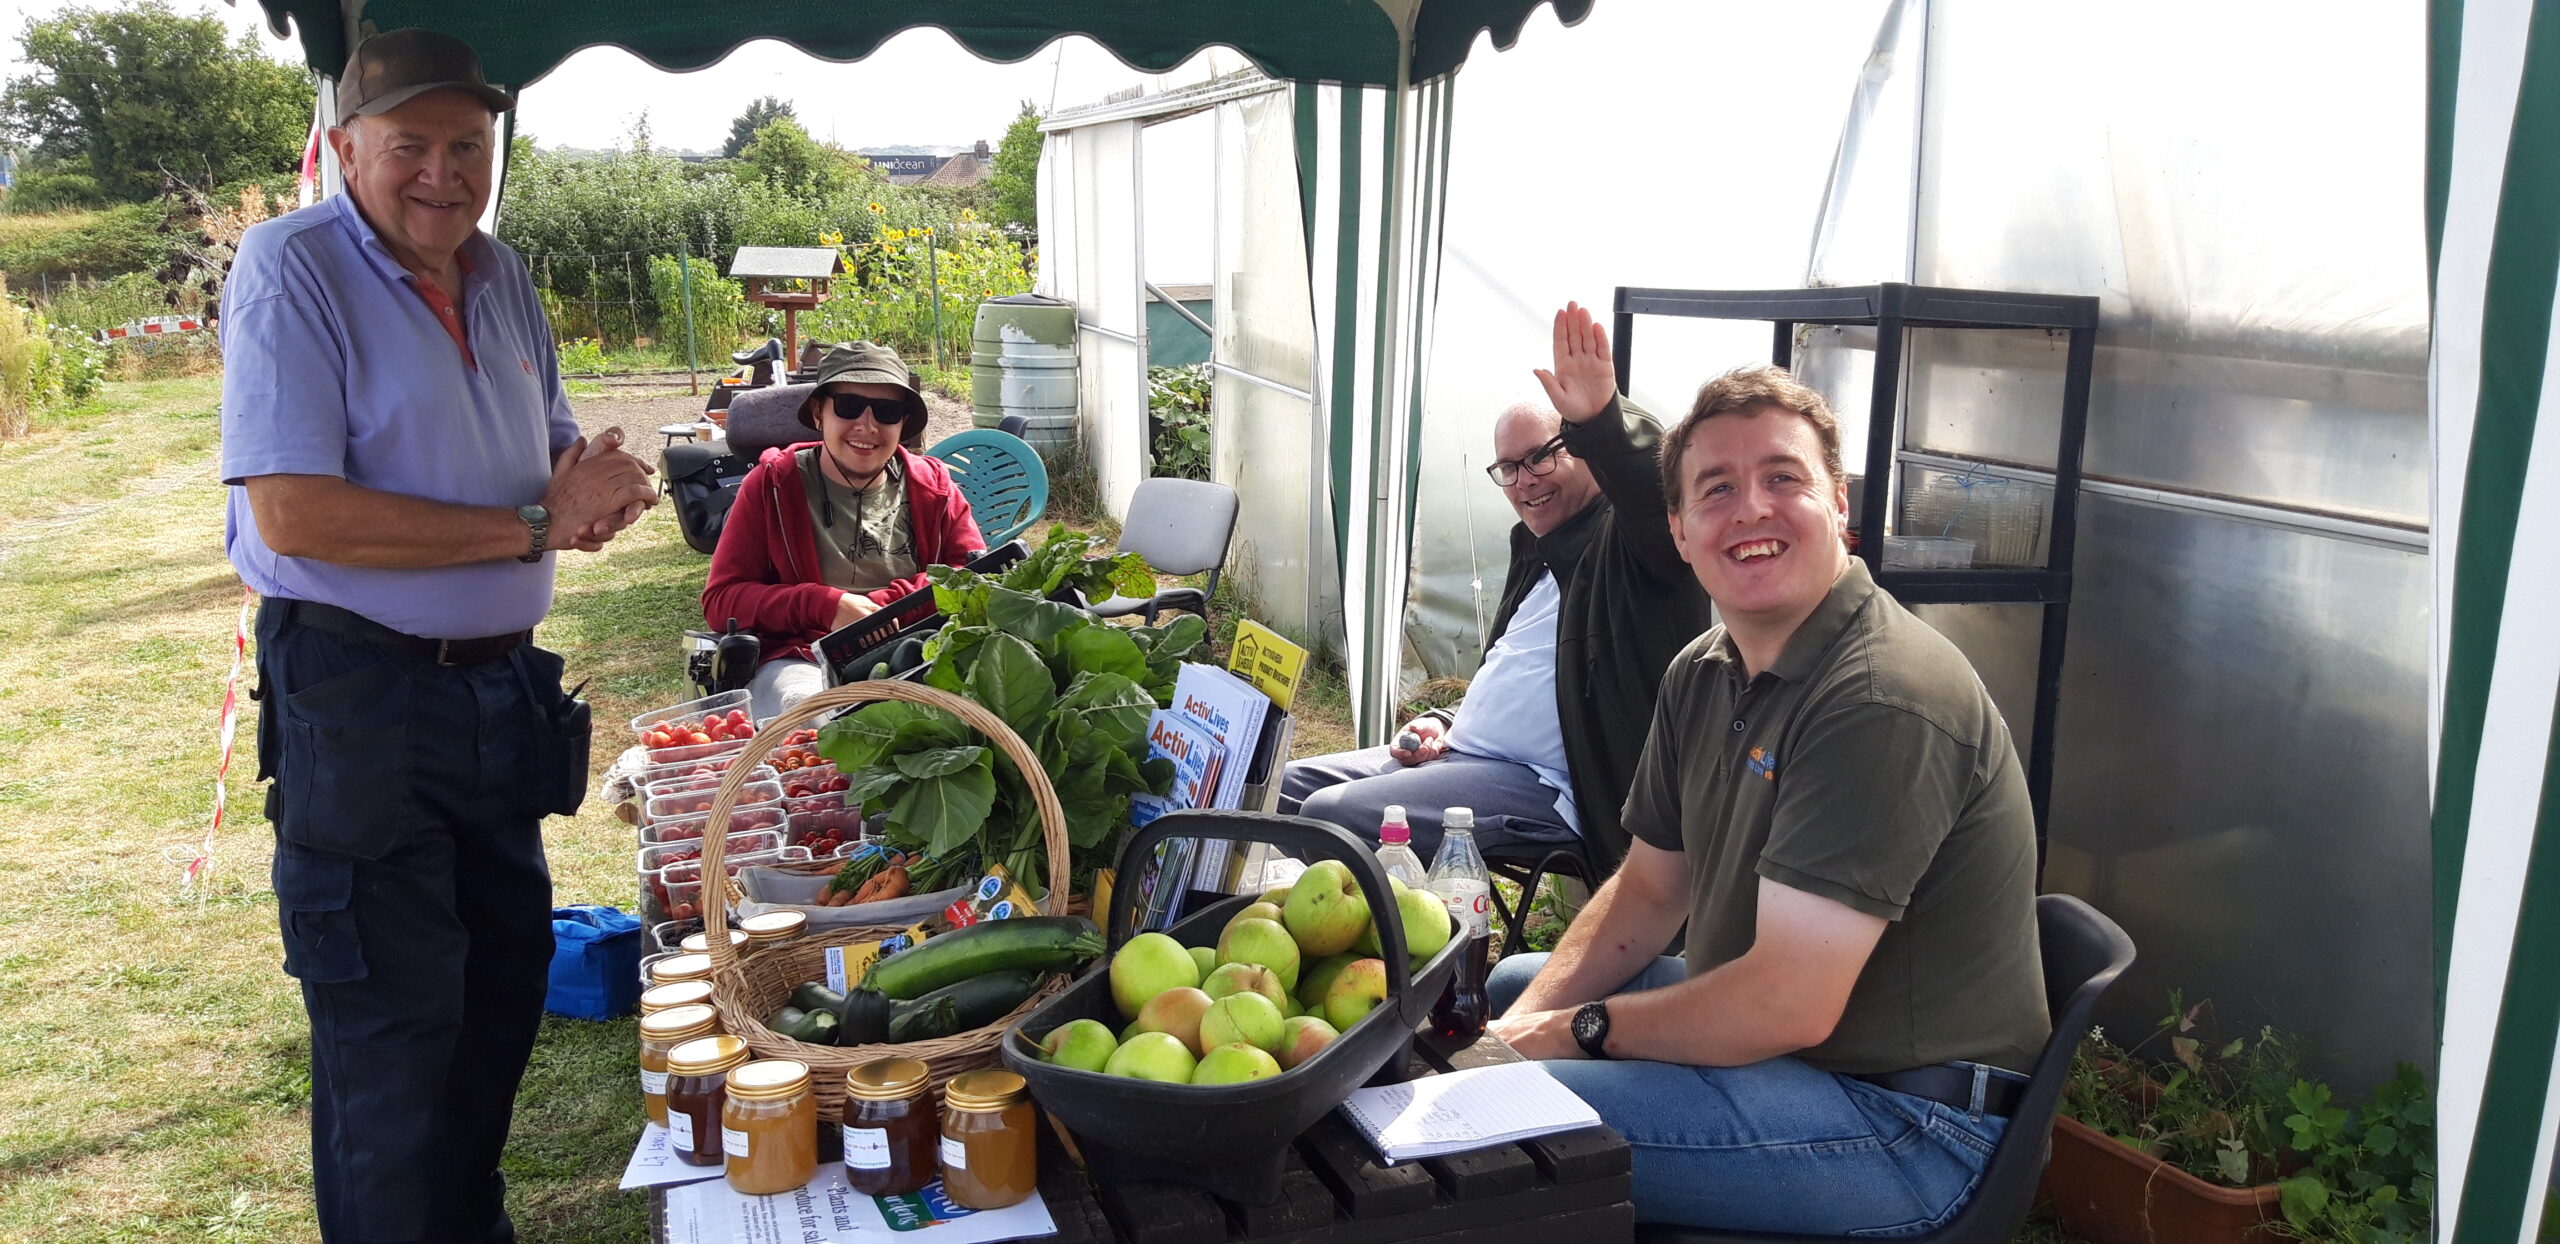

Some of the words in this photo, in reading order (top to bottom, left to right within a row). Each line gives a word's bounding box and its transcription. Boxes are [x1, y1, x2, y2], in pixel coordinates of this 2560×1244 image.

[1184, 694, 1230, 734] ActivLives
[1151, 719, 1205, 780] ActivLives
[794, 1186, 817, 1215] roduce
[827, 1186, 850, 1214] Plants
[800, 1215, 822, 1229] for
[834, 1215, 860, 1232] and
[802, 1229, 828, 1244] sal
